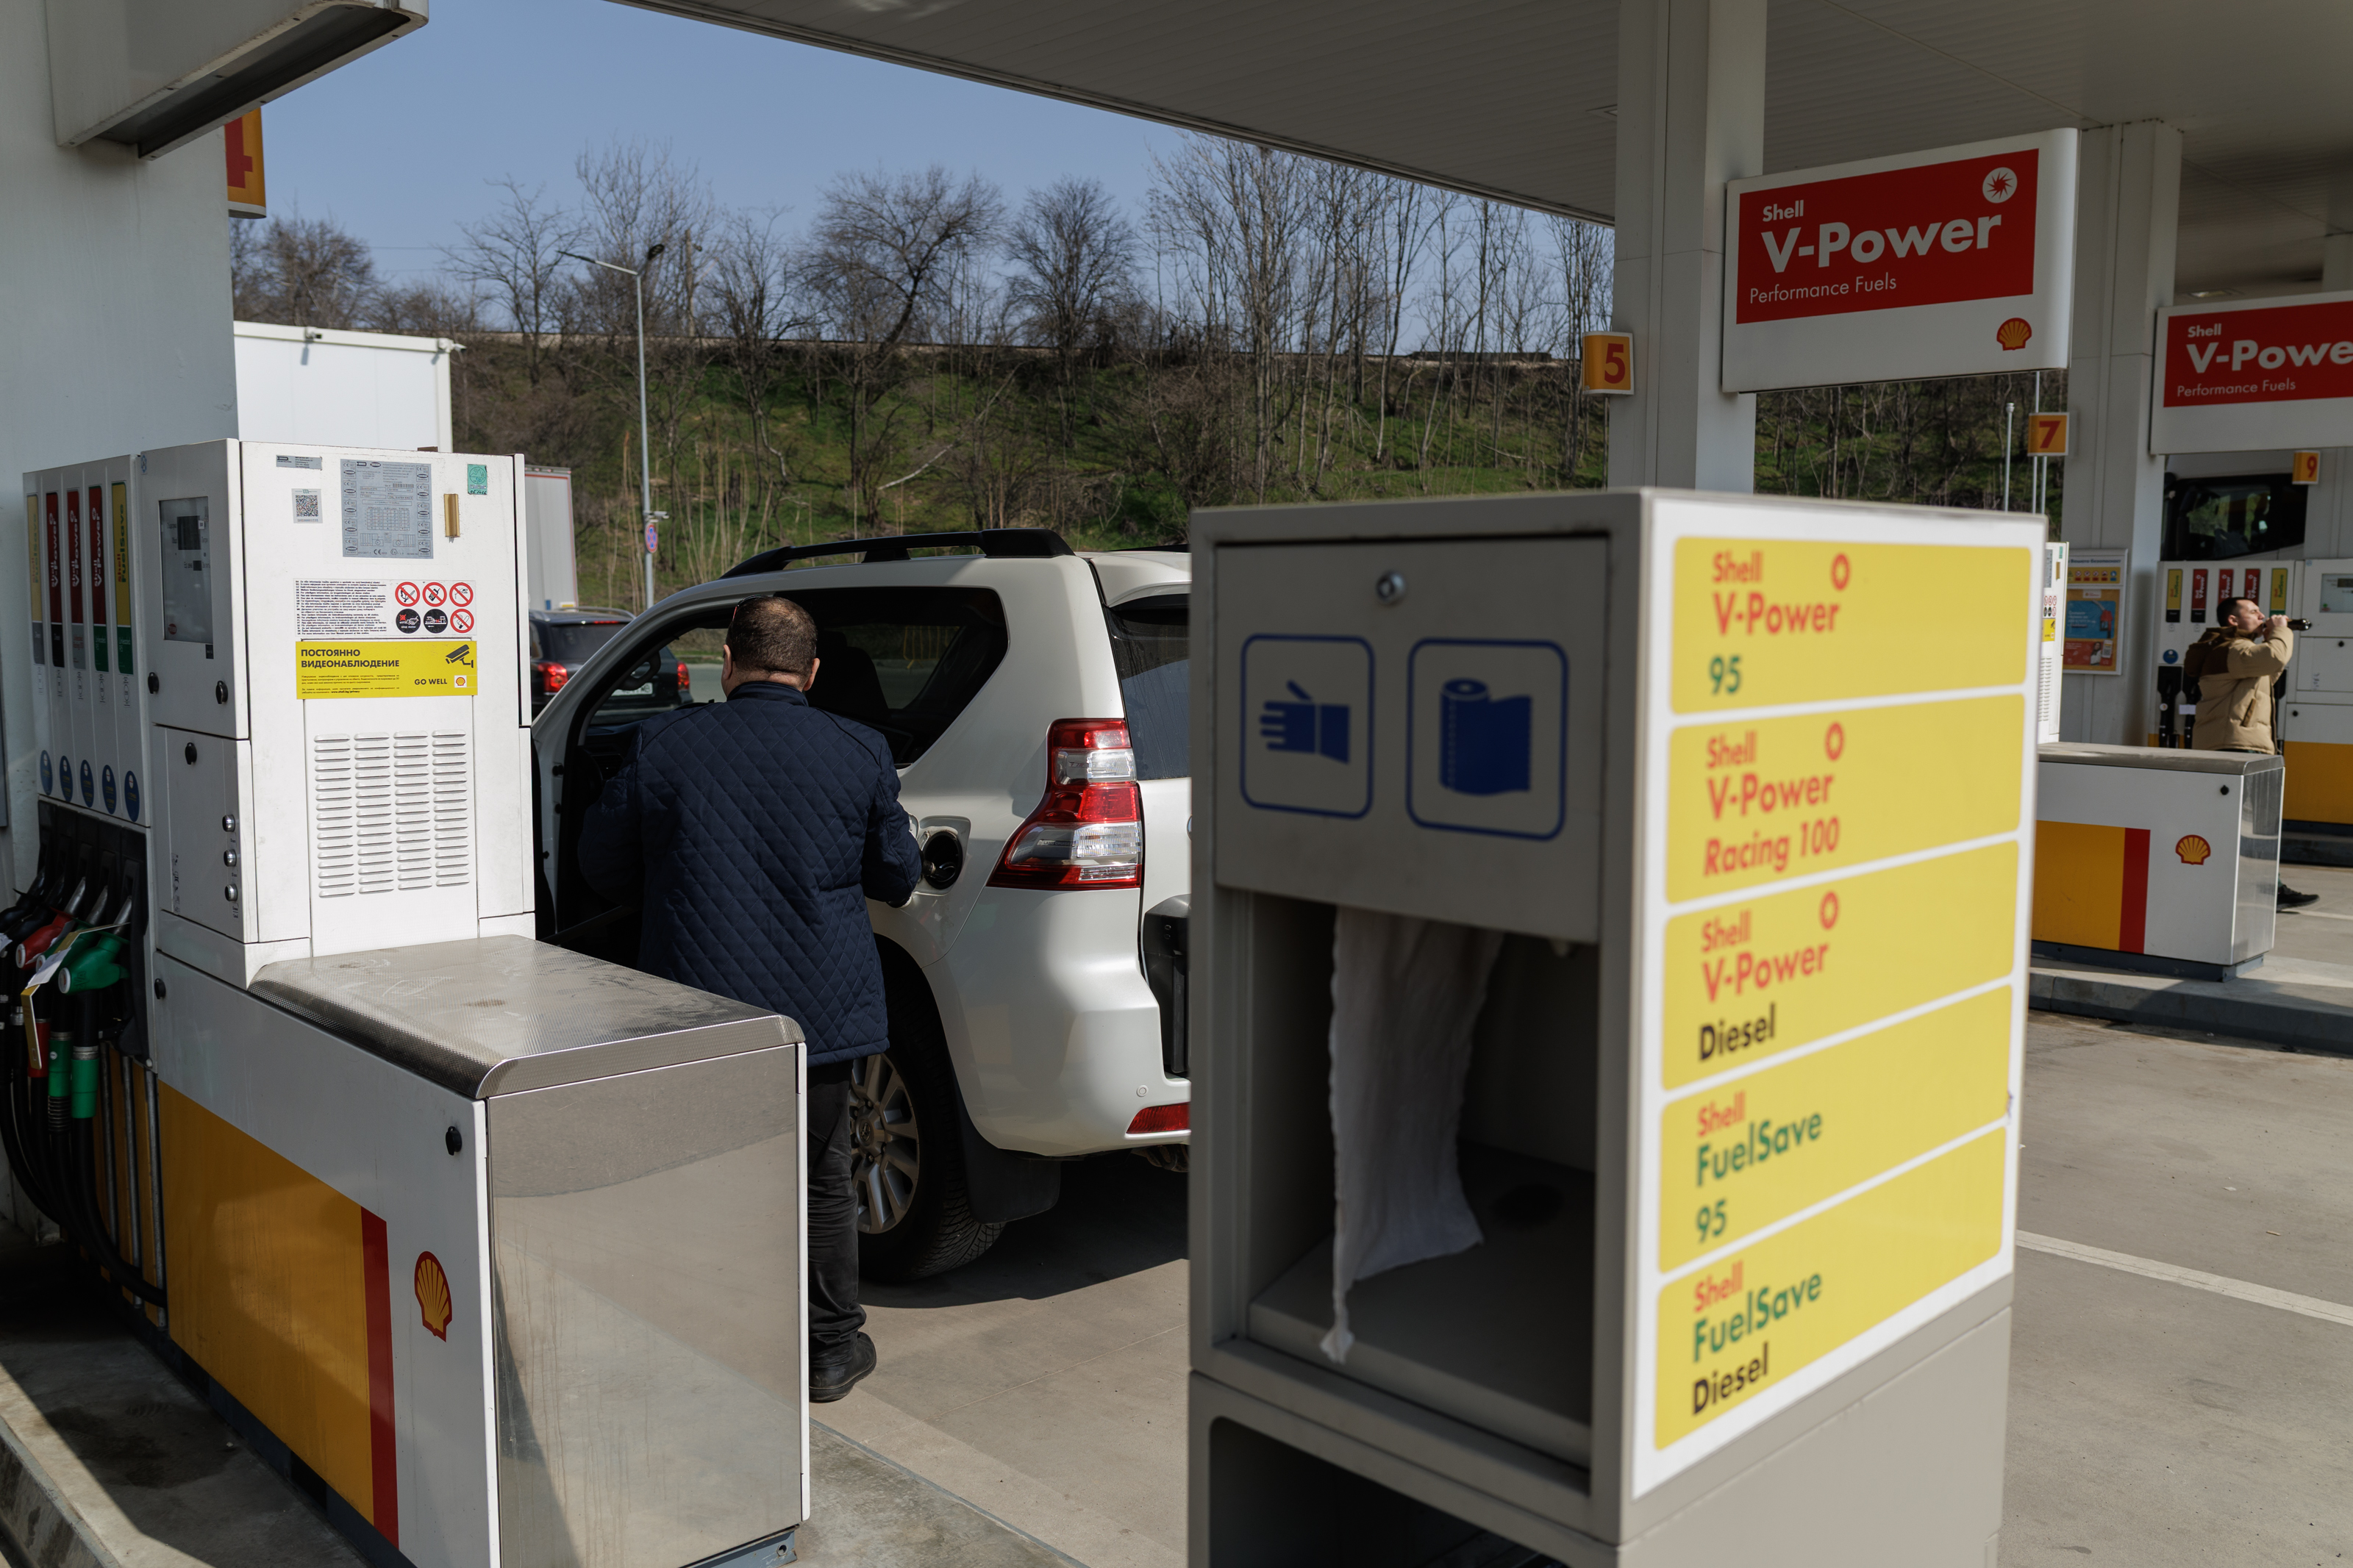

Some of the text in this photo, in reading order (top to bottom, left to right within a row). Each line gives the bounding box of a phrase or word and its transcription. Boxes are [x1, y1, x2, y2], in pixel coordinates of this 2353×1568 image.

[1763, 199, 1804, 222] Shell
[1761, 214, 2002, 273] V-Power
[1750, 272, 1897, 304] Performance Fuels
[2188, 323, 2221, 337] Shell
[1604, 343, 1626, 384] 5
[2177, 377, 2296, 397] Performance Fuels
[2039, 420, 2061, 448] 7
[2307, 455, 2318, 478] 9
[1713, 550, 1763, 584] Shell
[1713, 590, 1840, 636] V-Power
[301, 659, 399, 668] ВИДЕОНАБЛЮДЕНИЕ
[1710, 655, 1741, 694] 95
[1707, 731, 1757, 769] Shell
[1707, 772, 1834, 820] V-Power
[1704, 815, 1840, 877] Racing 100
[1702, 909, 1752, 953] Shell
[1703, 943, 1829, 1002] V-Power
[1699, 1001, 1776, 1062] Diesel
[1698, 1090, 1746, 1137] Shell
[1697, 1112, 1822, 1187] FuelSave
[1696, 1198, 1727, 1244] 95
[1694, 1260, 1743, 1312] Shell
[1693, 1272, 1822, 1363] FuelSave
[1693, 1340, 1769, 1415] Diesel
